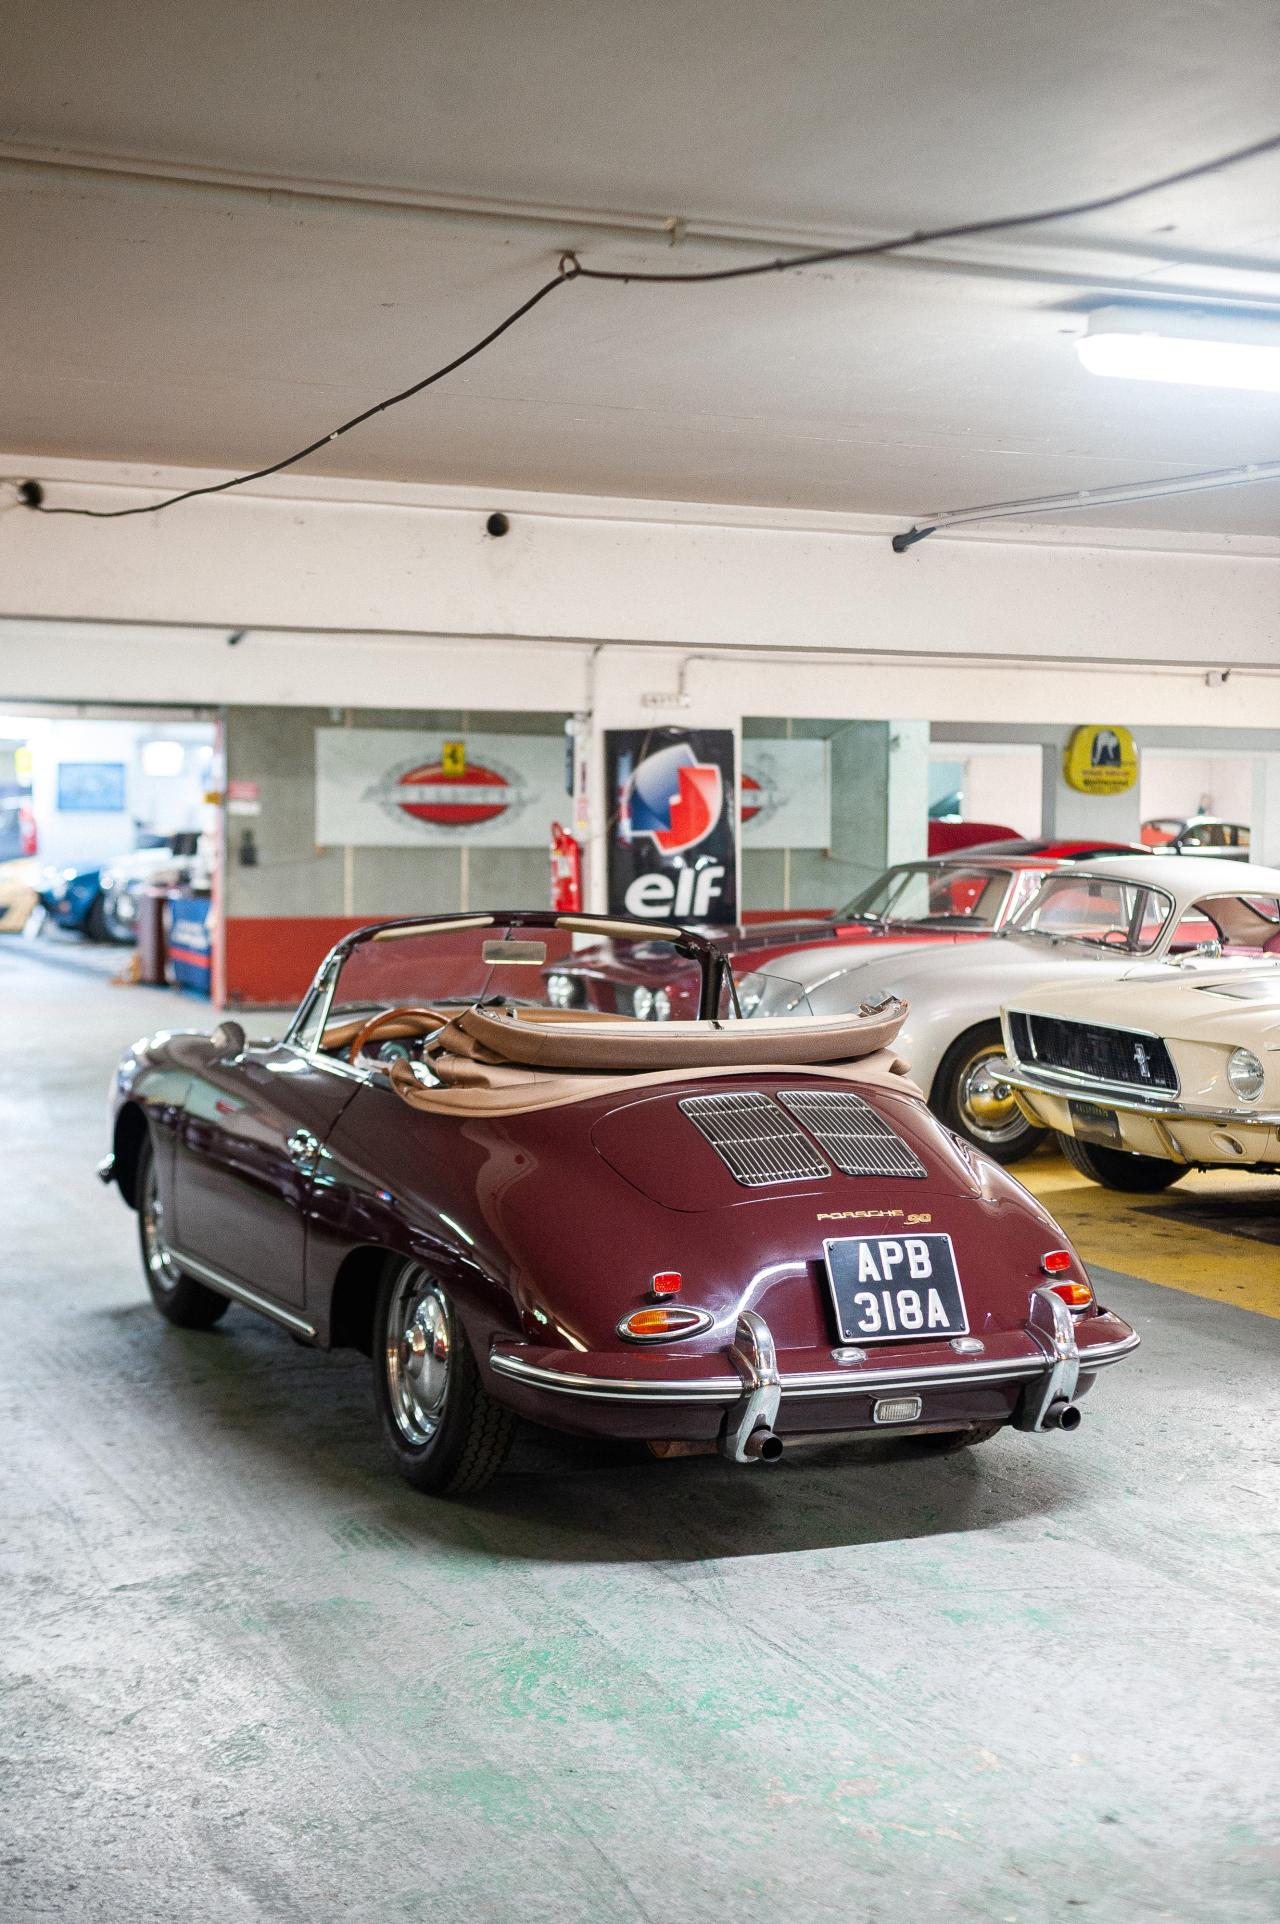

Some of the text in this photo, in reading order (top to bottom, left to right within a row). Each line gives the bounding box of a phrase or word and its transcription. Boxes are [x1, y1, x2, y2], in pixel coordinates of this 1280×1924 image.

[625, 866, 725, 918] elf
[817, 1210, 904, 1221] PORSCHE
[858, 1239, 932, 1282] APB
[854, 1288, 950, 1332] 318A
